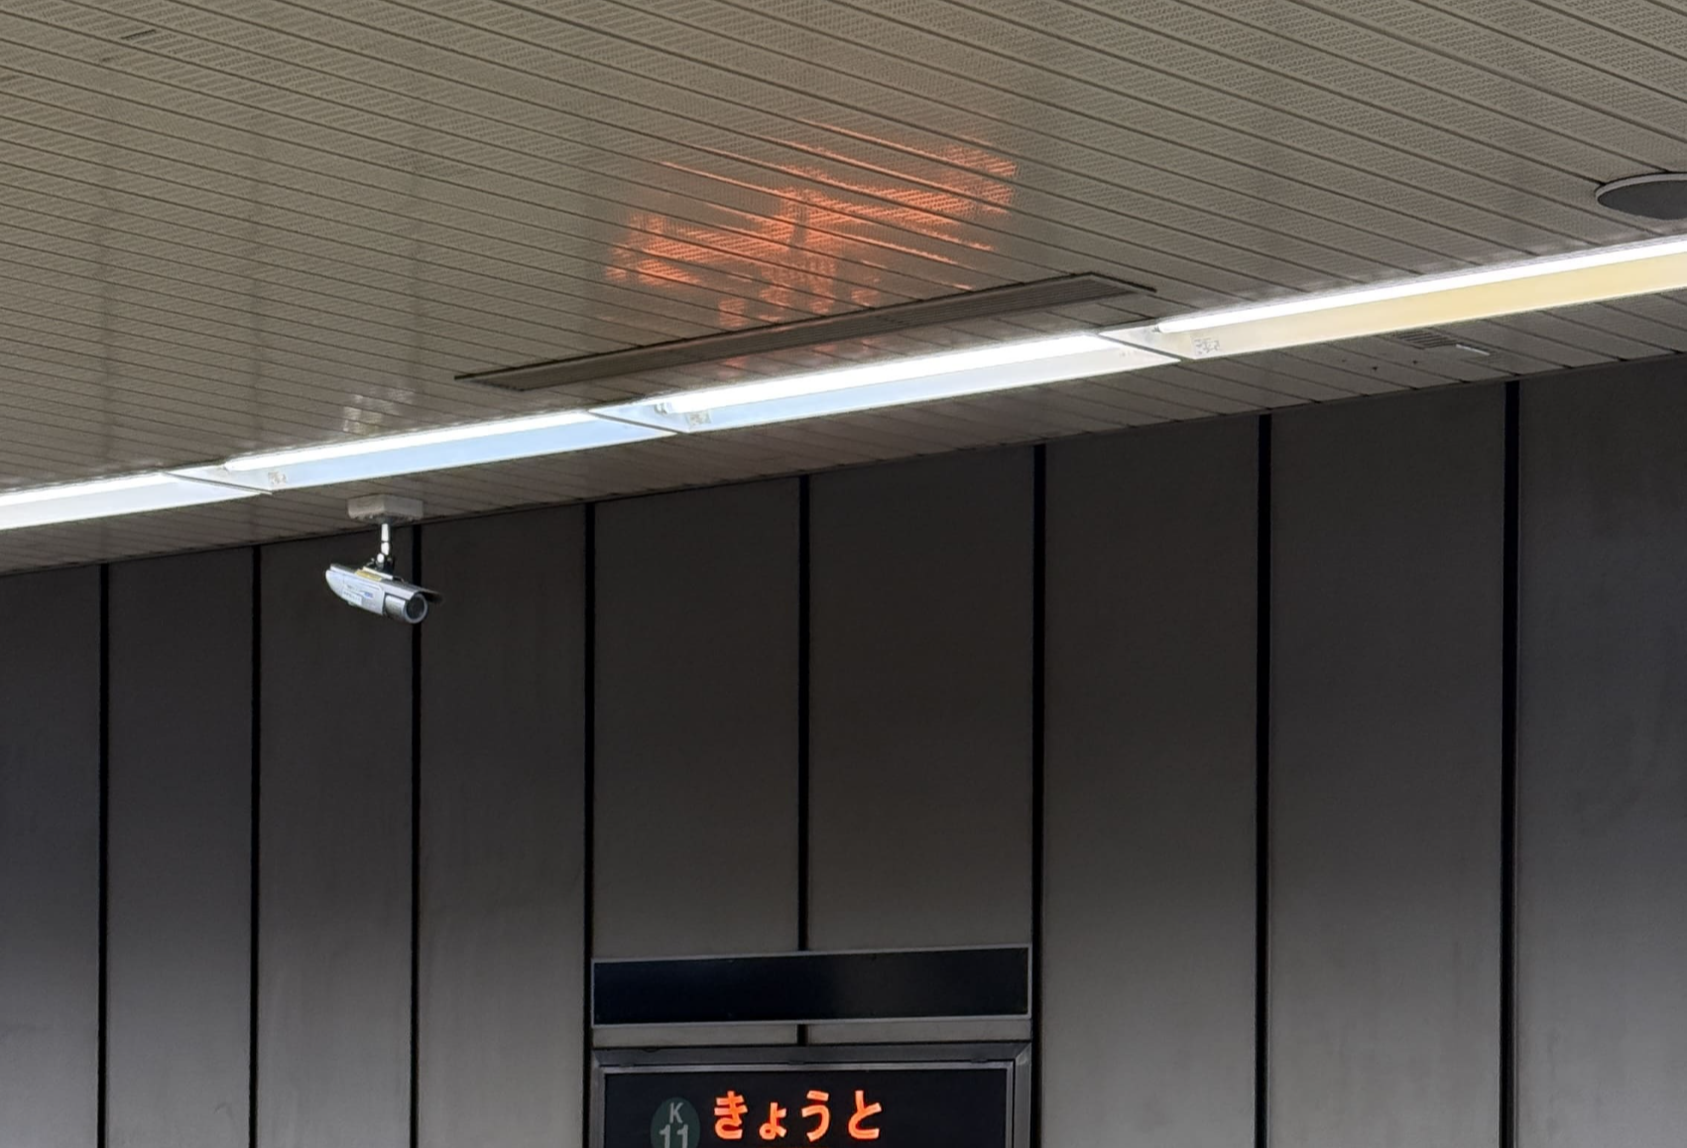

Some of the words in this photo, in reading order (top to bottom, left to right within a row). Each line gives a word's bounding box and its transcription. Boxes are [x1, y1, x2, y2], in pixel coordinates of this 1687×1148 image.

[668, 1103, 683, 1124] K
[714, 1090, 882, 1142] きょうと
